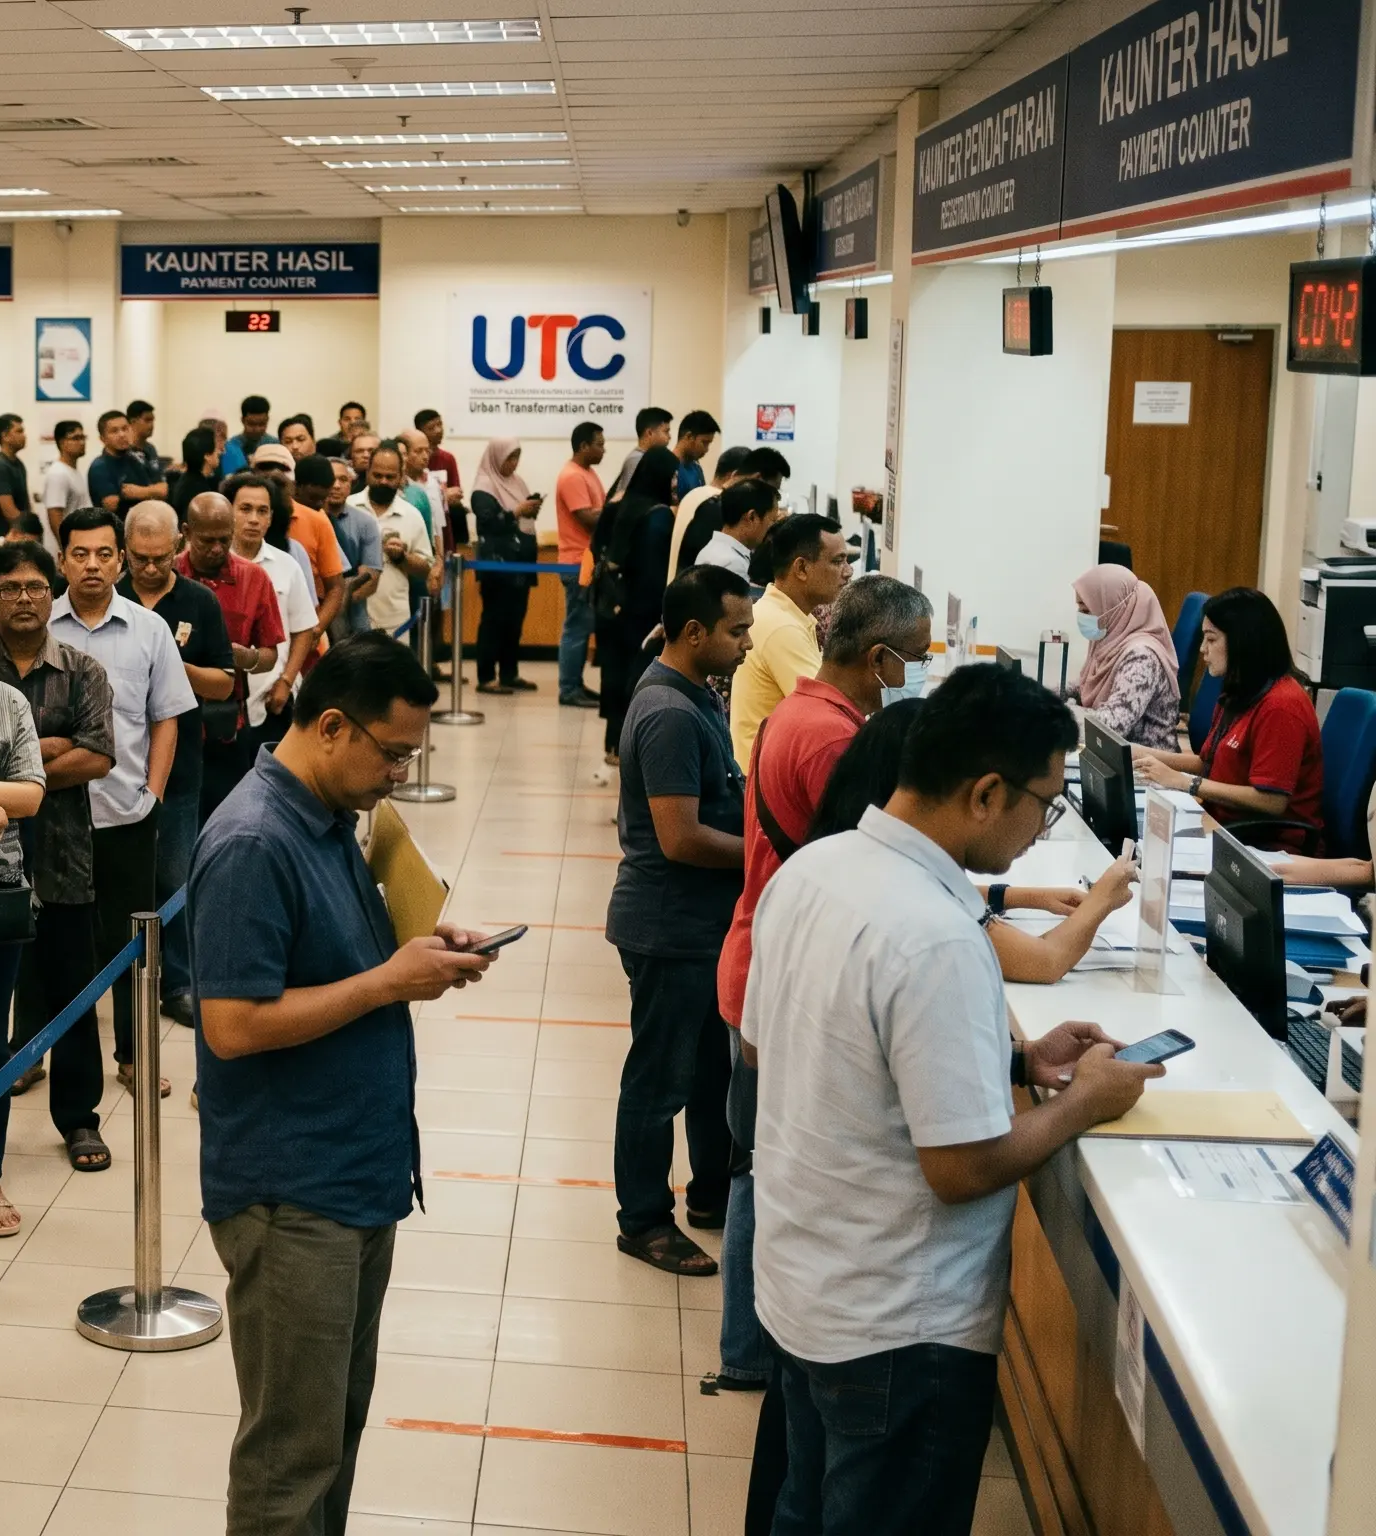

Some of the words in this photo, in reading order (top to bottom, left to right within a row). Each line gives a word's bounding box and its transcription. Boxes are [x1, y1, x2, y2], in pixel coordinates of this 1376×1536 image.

[1099, 11, 1199, 125] KAUNTER
[1206, 0, 1289, 83] HASIL
[918, 132, 963, 195] KAUNTER
[964, 84, 1056, 179] PENDAFTARAN
[1118, 121, 1176, 182] PAYMENT
[1178, 97, 1252, 166] COUNTER
[145, 252, 269, 273] KAUNTER
[276, 251, 354, 271] HASIL
[180, 277, 246, 289] PAYMENT
[249, 277, 317, 288] COUNTER
[248, 313, 271, 331] 22
[471, 314, 626, 381] UTC
[469, 402, 501, 413] Urban
[505, 402, 585, 413] Transformation
[588, 402, 624, 413] Centre
